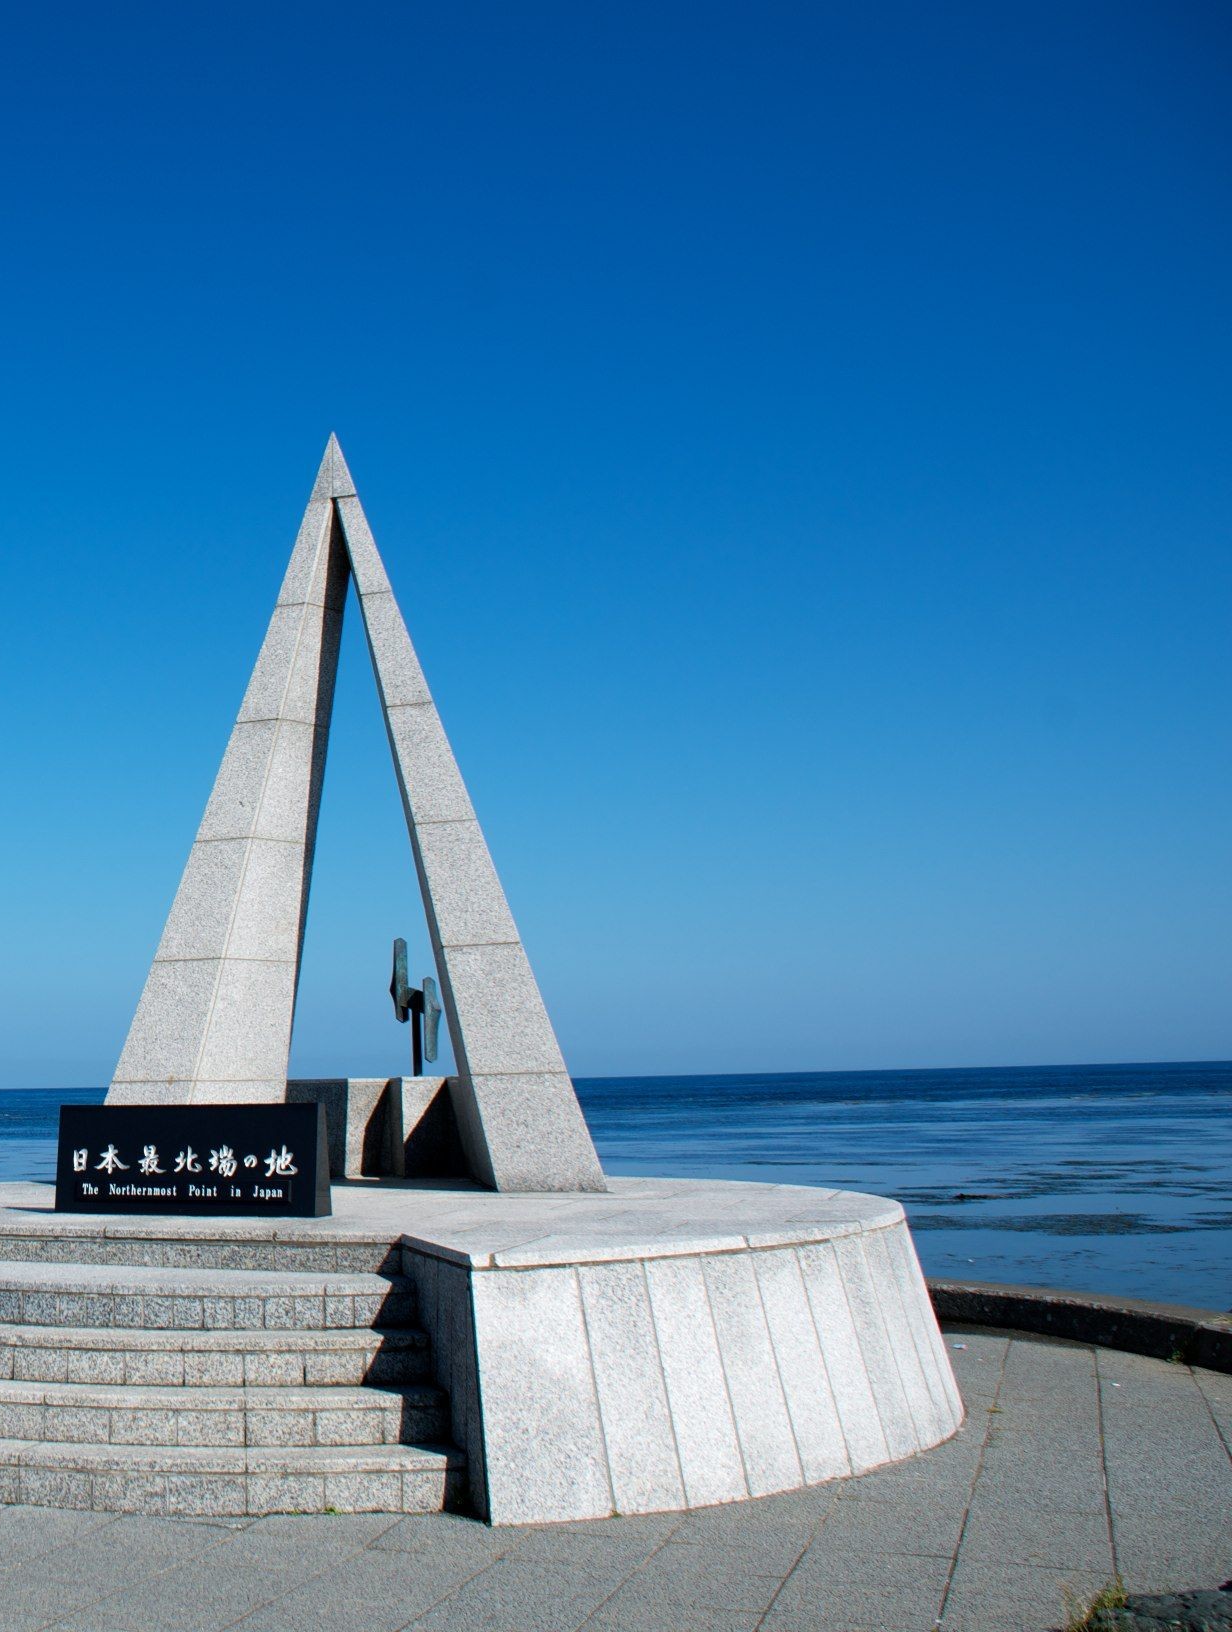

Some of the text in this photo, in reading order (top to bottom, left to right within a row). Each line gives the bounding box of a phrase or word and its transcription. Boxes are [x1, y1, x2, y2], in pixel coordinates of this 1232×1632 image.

[72, 1144, 299, 1178] 日本最北端の地
[82, 1183, 283, 1200] The Northernmost Point in Japan
